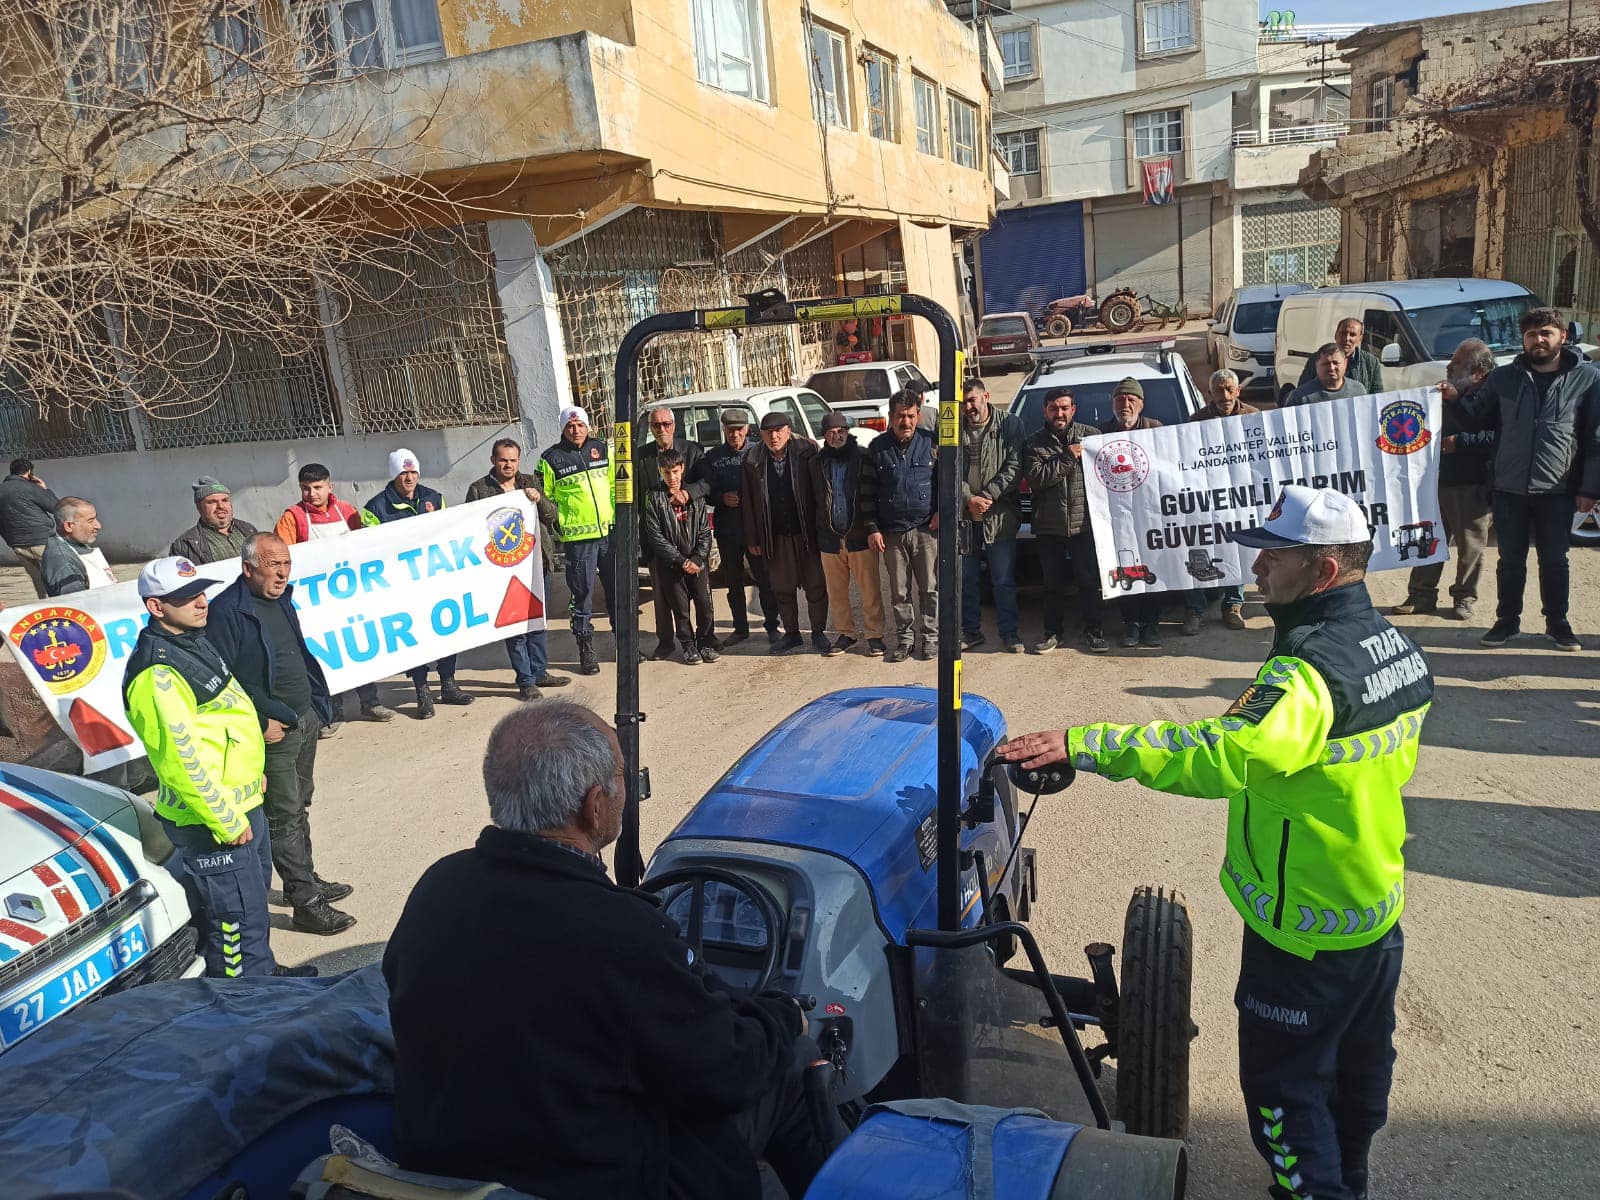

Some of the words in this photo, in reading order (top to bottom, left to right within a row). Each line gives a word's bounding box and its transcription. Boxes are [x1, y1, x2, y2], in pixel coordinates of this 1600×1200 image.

[1198, 439, 1264, 457] GAZİANTEP
[1244, 427, 1265, 438] T.C.
[1178, 460, 1189, 472] İL
[1191, 453, 1256, 470] JANDARMA
[1258, 440, 1339, 460] KOMUTANLIĞI
[1160, 478, 1272, 517] GÜVENLİ
[397, 535, 482, 581] TAK
[13, 608, 97, 641] ANDARMA
[431, 592, 489, 636] OL
[14, 992, 45, 1033] 27
[58, 961, 101, 1006] JAA
[106, 930, 144, 970] 154
[1244, 993, 1308, 1026] JANDARMA
